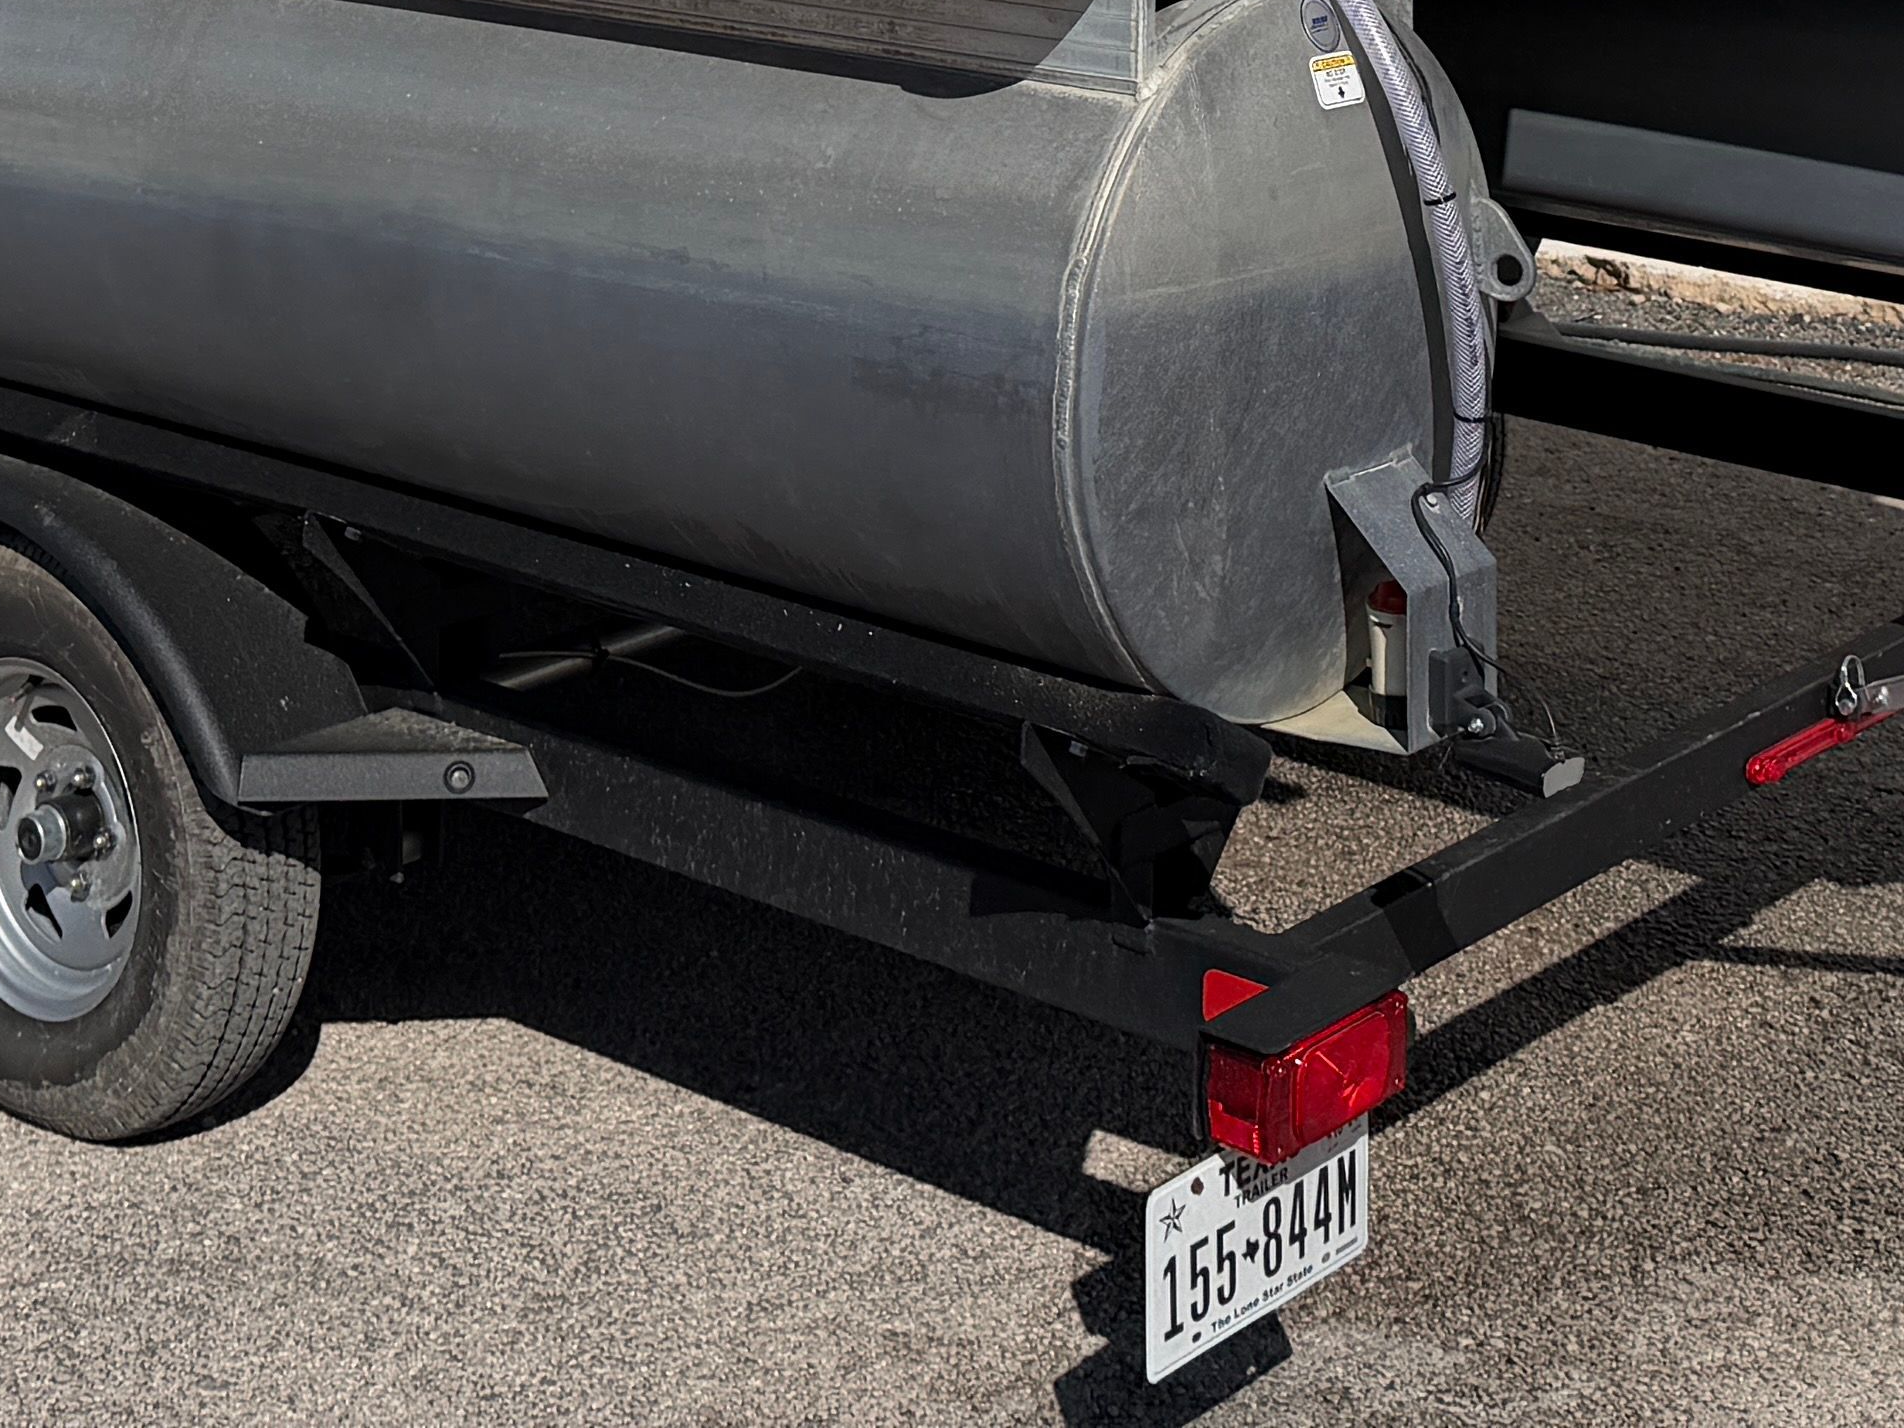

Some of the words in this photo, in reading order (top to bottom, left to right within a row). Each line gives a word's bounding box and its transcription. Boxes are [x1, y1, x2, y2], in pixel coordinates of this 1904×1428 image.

[1233, 1167, 1288, 1209] TRAILER
[1162, 1220, 1236, 1343] 155
[1262, 1149, 1357, 1279] 844M
[1210, 1315, 1232, 1334] The
[1233, 1297, 1260, 1319] Lone
[1261, 1282, 1284, 1303] Star
[1286, 1264, 1314, 1288] State
